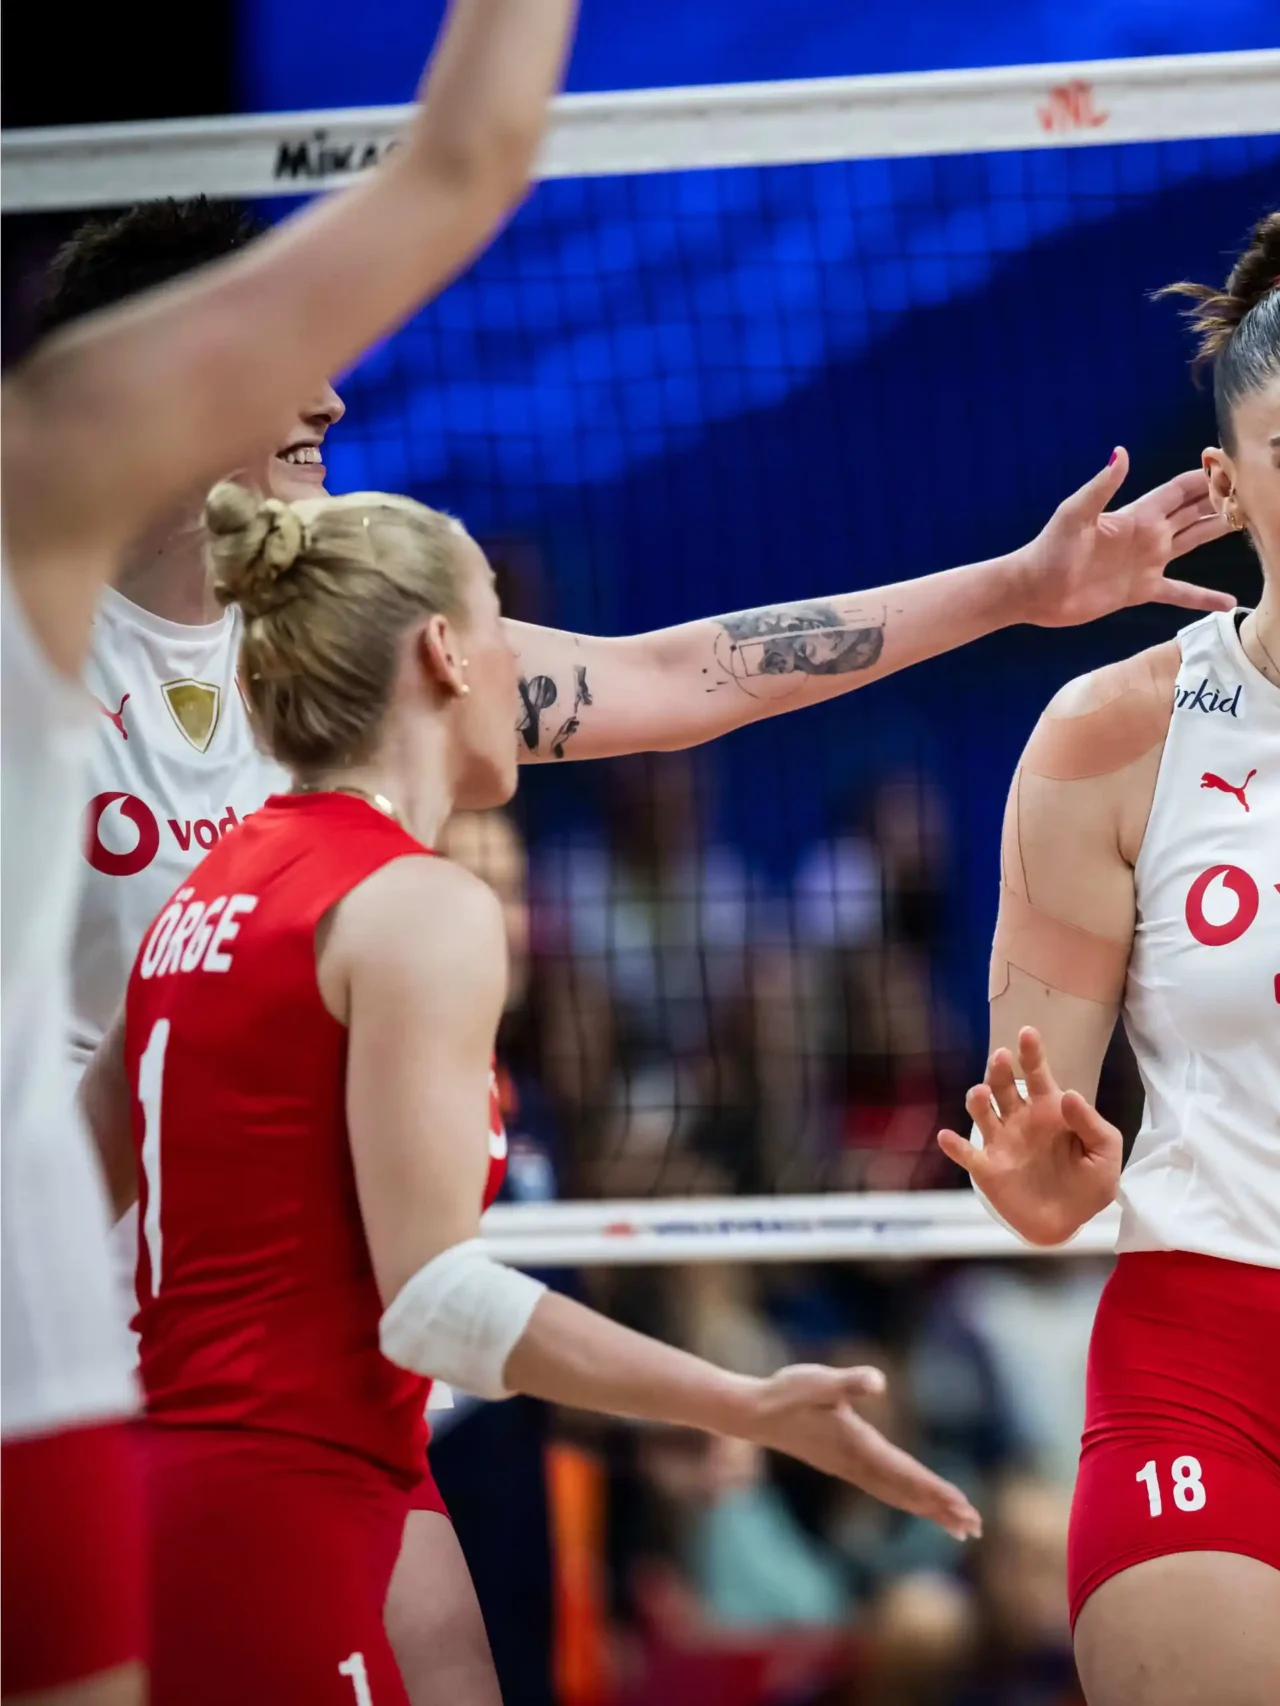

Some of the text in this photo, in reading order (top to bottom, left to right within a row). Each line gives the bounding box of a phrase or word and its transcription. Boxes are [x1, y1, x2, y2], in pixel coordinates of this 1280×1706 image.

[1174, 678, 1243, 718] rkid
[140, 886, 259, 980] ÖRGE
[138, 1018, 170, 1299] 1
[1136, 1455, 1207, 1518] 18
[338, 1651, 373, 1706] 1
